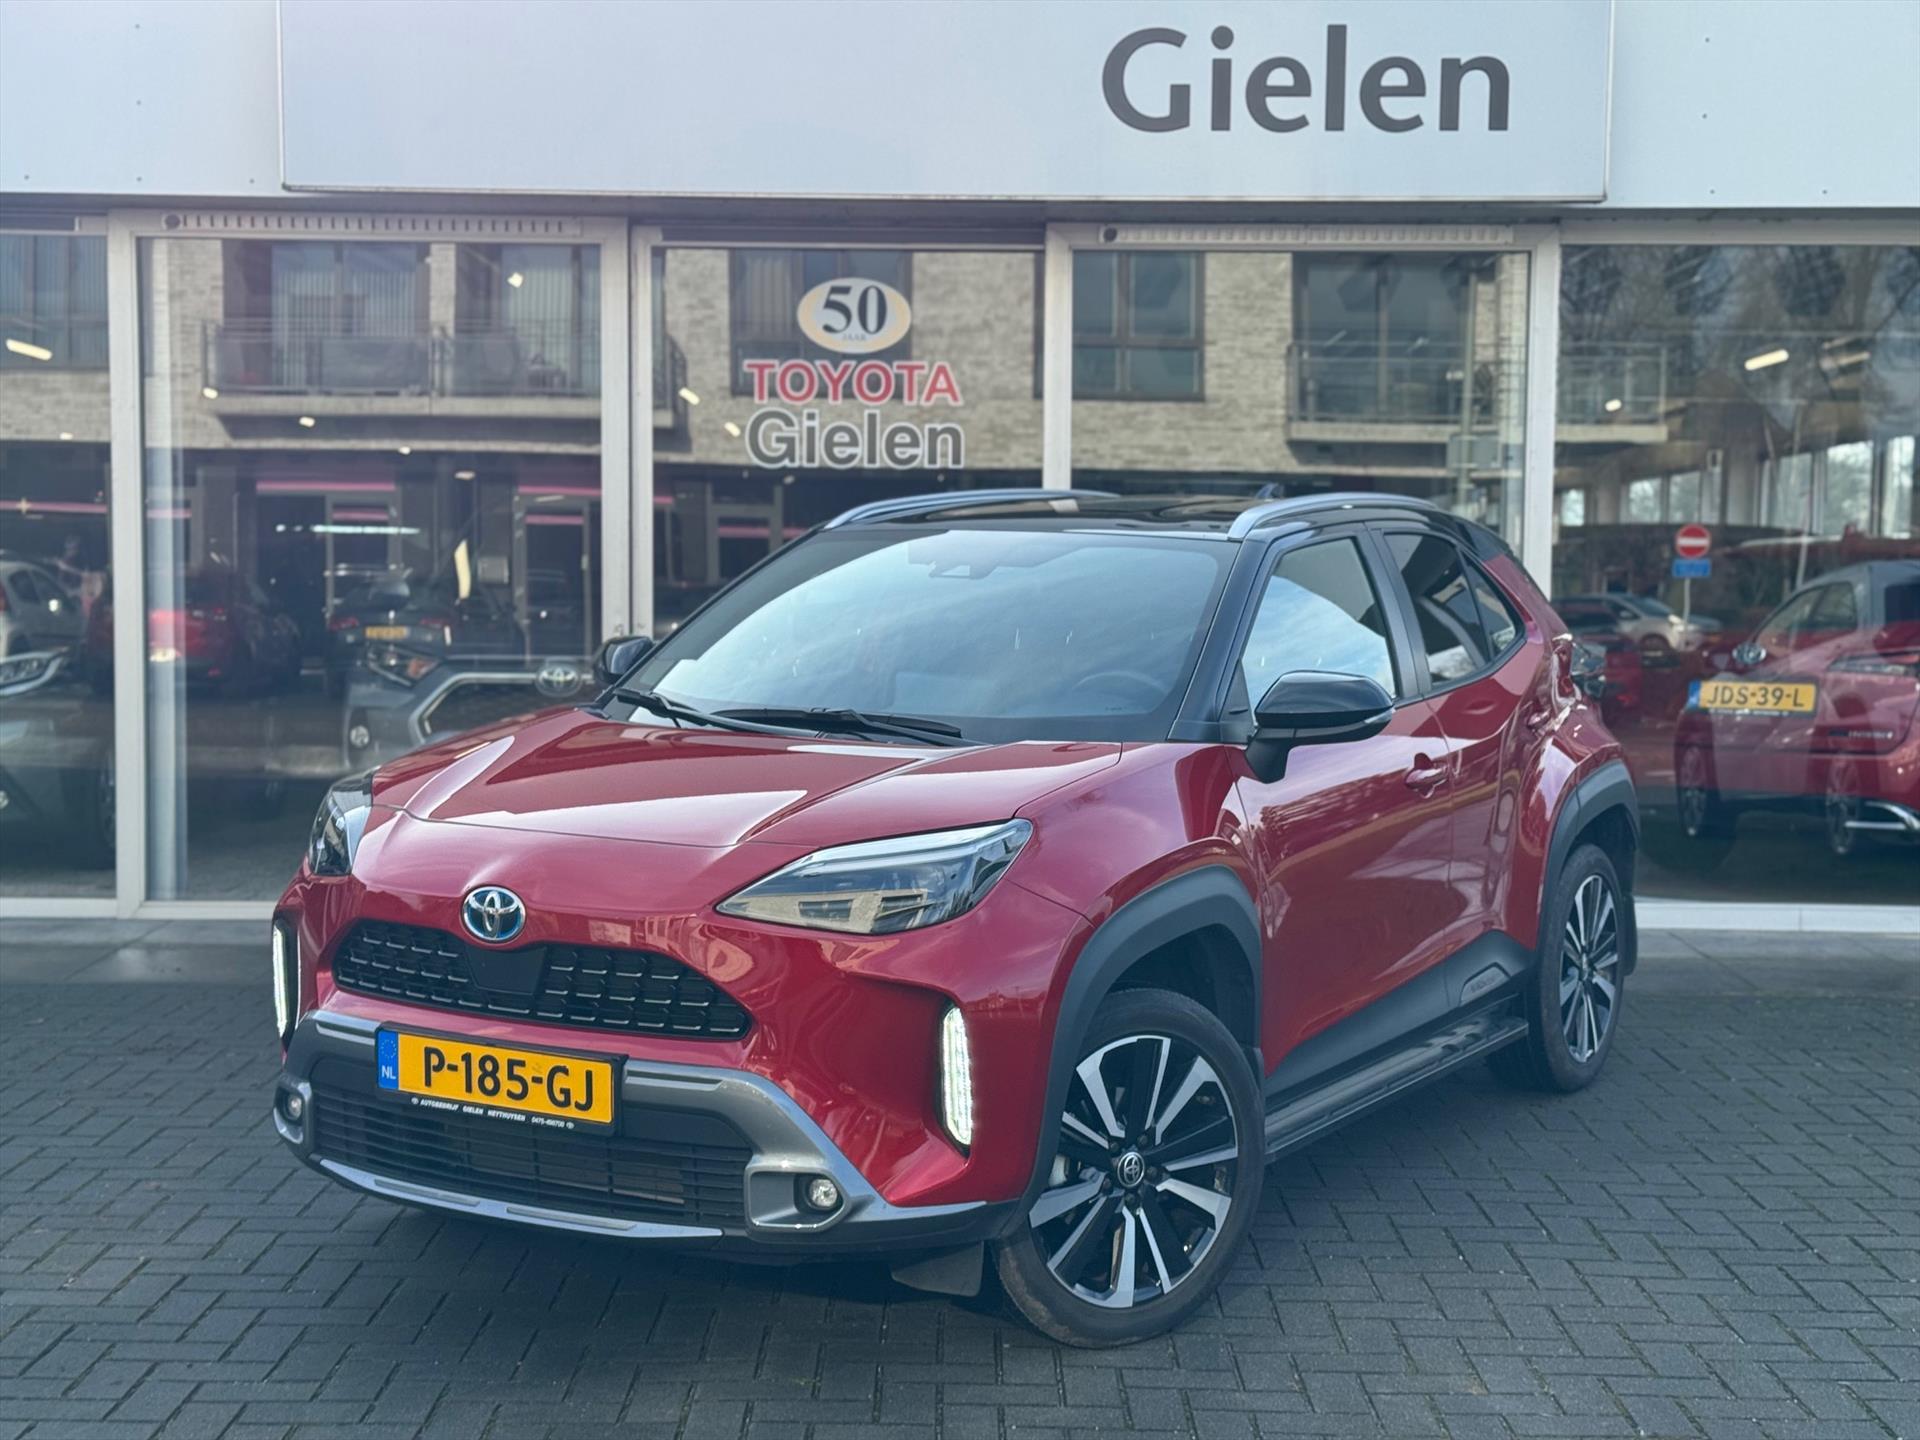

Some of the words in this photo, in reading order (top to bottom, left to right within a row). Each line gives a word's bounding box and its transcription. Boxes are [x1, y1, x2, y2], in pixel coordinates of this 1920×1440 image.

[1101, 24, 1510, 133] Gielen
[822, 285, 887, 335] 50
[744, 360, 962, 405] TOYOTA
[746, 408, 963, 468] Gielen
[1708, 685, 1804, 708] JDS-39-L
[381, 1066, 396, 1080] NL
[423, 1046, 593, 1112] P-185-GJ
